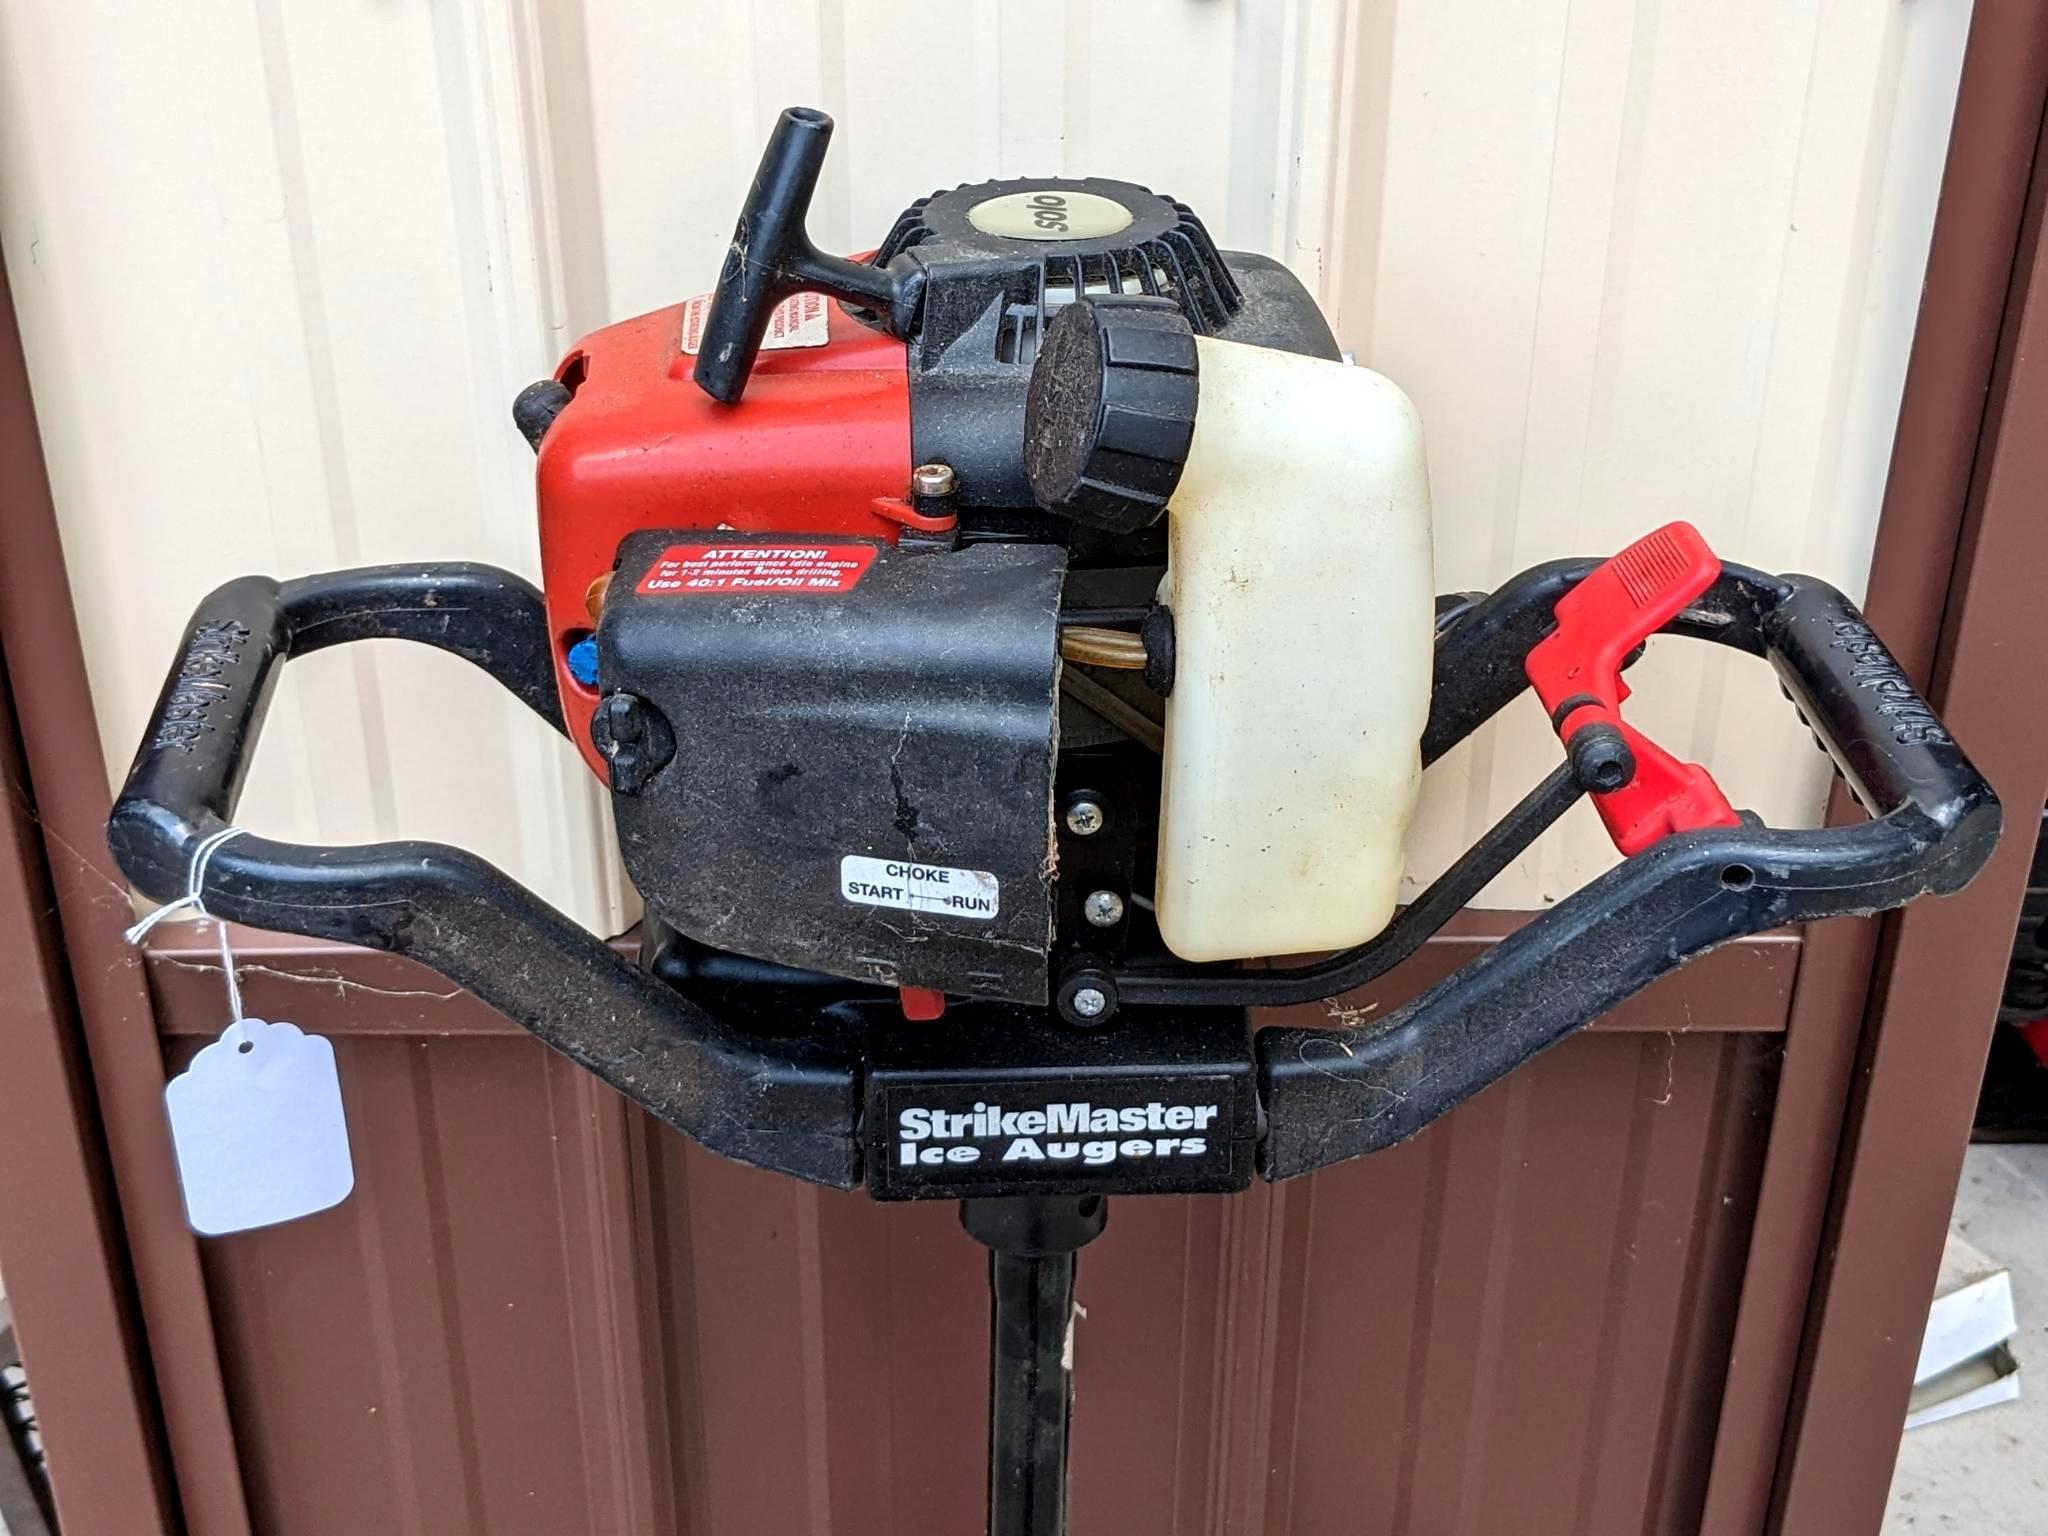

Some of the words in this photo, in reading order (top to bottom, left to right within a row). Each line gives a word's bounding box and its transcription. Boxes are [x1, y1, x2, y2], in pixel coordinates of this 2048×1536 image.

[1026, 195, 1069, 232] solo
[702, 550, 828, 559] ATTENTION!
[660, 569, 677, 577] for
[711, 560, 788, 569] performance
[790, 560, 815, 568] idle
[816, 561, 858, 569] engine
[647, 580, 682, 589] Use
[686, 578, 725, 588] 40:1
[731, 578, 803, 587] Fuel/Oil
[806, 579, 842, 588] Mix
[886, 864, 950, 883] CHOKE
[848, 882, 904, 900] START
[952, 895, 990, 912] RUN
[899, 1101, 1218, 1140] StrikeMaster
[900, 1142, 981, 1165] Ice
[1002, 1137, 1207, 1165] Augers
